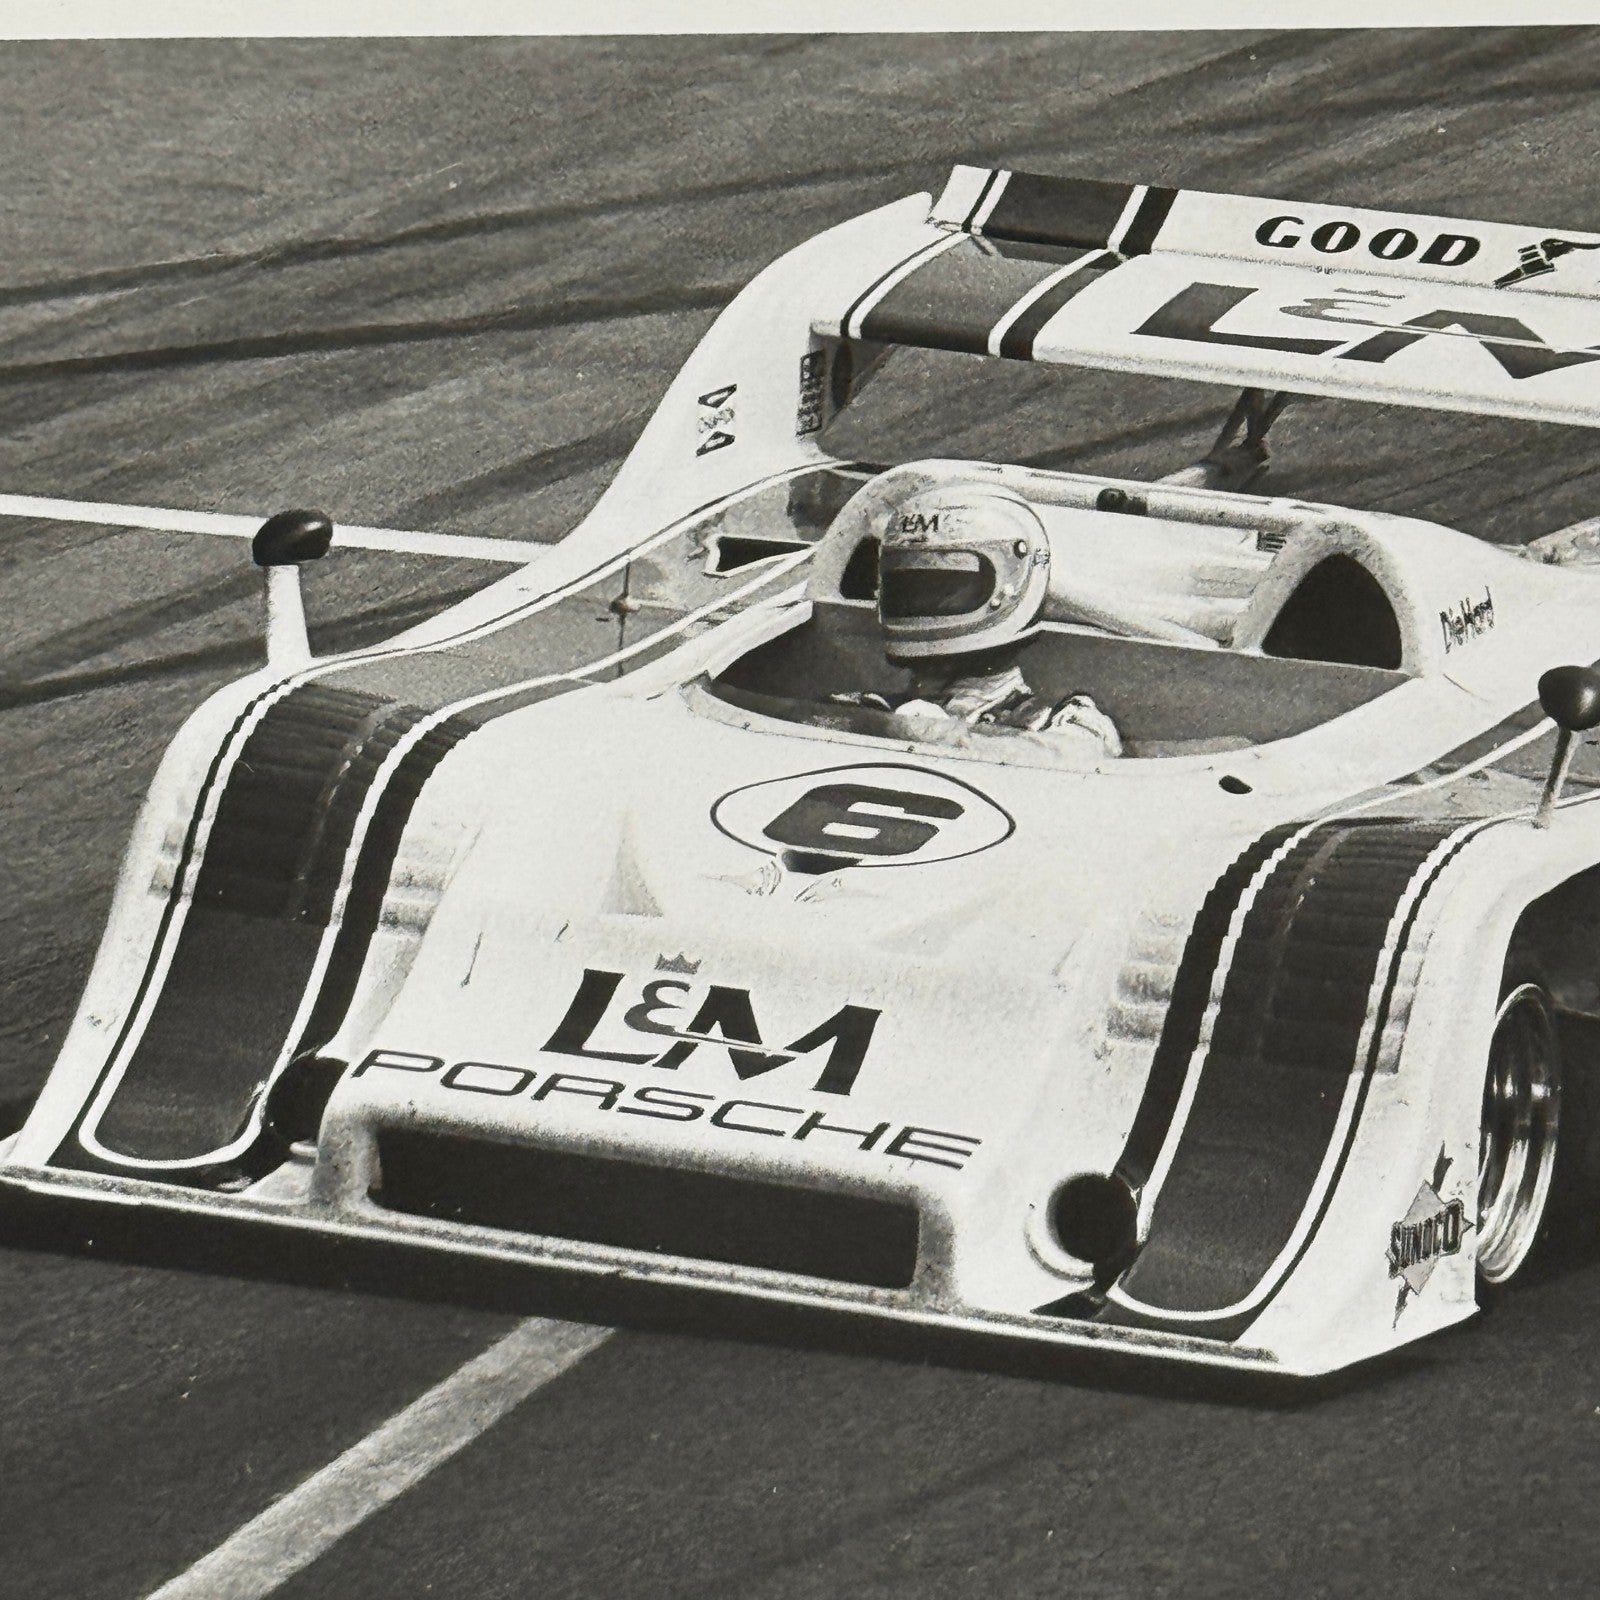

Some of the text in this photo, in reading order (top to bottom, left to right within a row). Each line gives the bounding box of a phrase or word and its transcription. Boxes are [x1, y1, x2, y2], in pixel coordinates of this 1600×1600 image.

[1254, 215, 1481, 267] GOOD
[762, 783, 965, 856] 6
[540, 968, 883, 1096] L&M
[350, 1048, 983, 1170] PORSCHE
